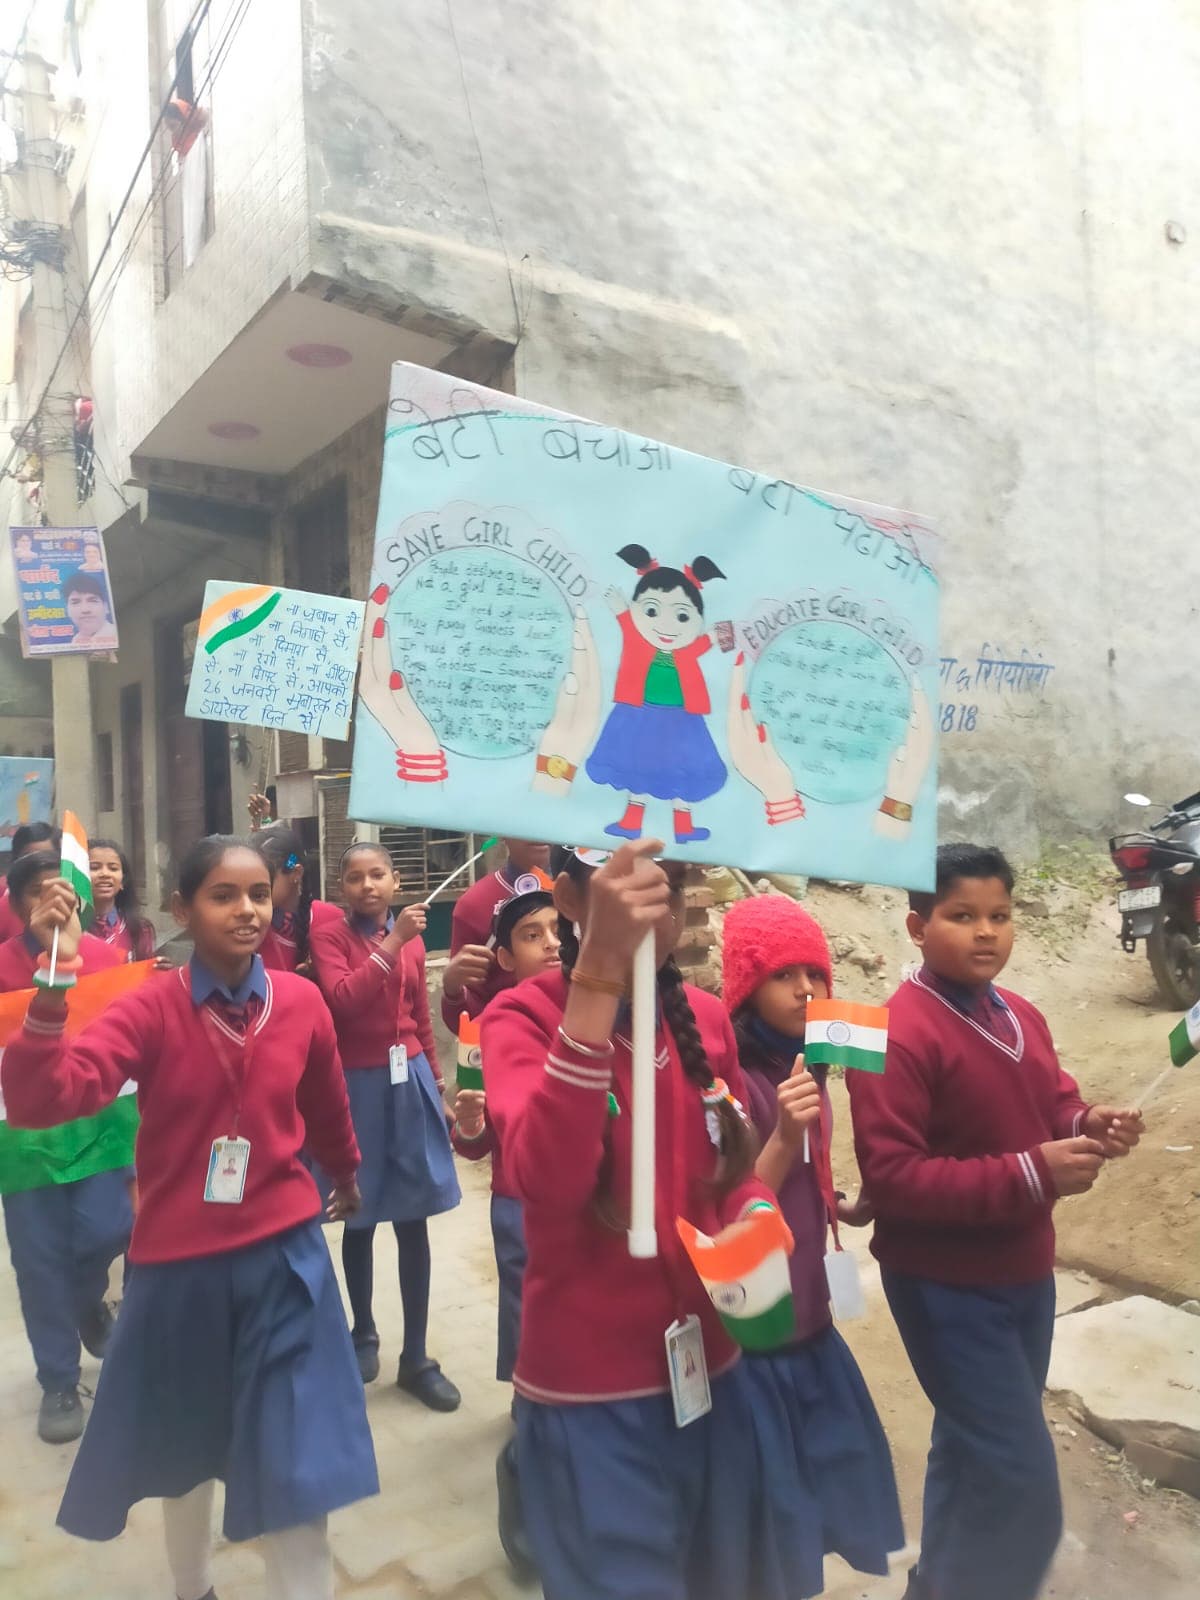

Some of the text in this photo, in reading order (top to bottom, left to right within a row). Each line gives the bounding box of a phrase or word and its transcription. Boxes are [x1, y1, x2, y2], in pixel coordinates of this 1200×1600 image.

[389, 388, 503, 468] बेटी
[727, 467, 797, 516] बटी
[463, 516, 513, 548] GIRL
[526, 538, 588, 597] CHILD
[741, 597, 821, 651] EDUCATE
[274, 634, 309, 657] दिमाग
[202, 677, 222, 695] 26
[231, 682, 281, 703] जनवरी
[307, 678, 350, 699] आपको
[261, 703, 289, 727] दिल
